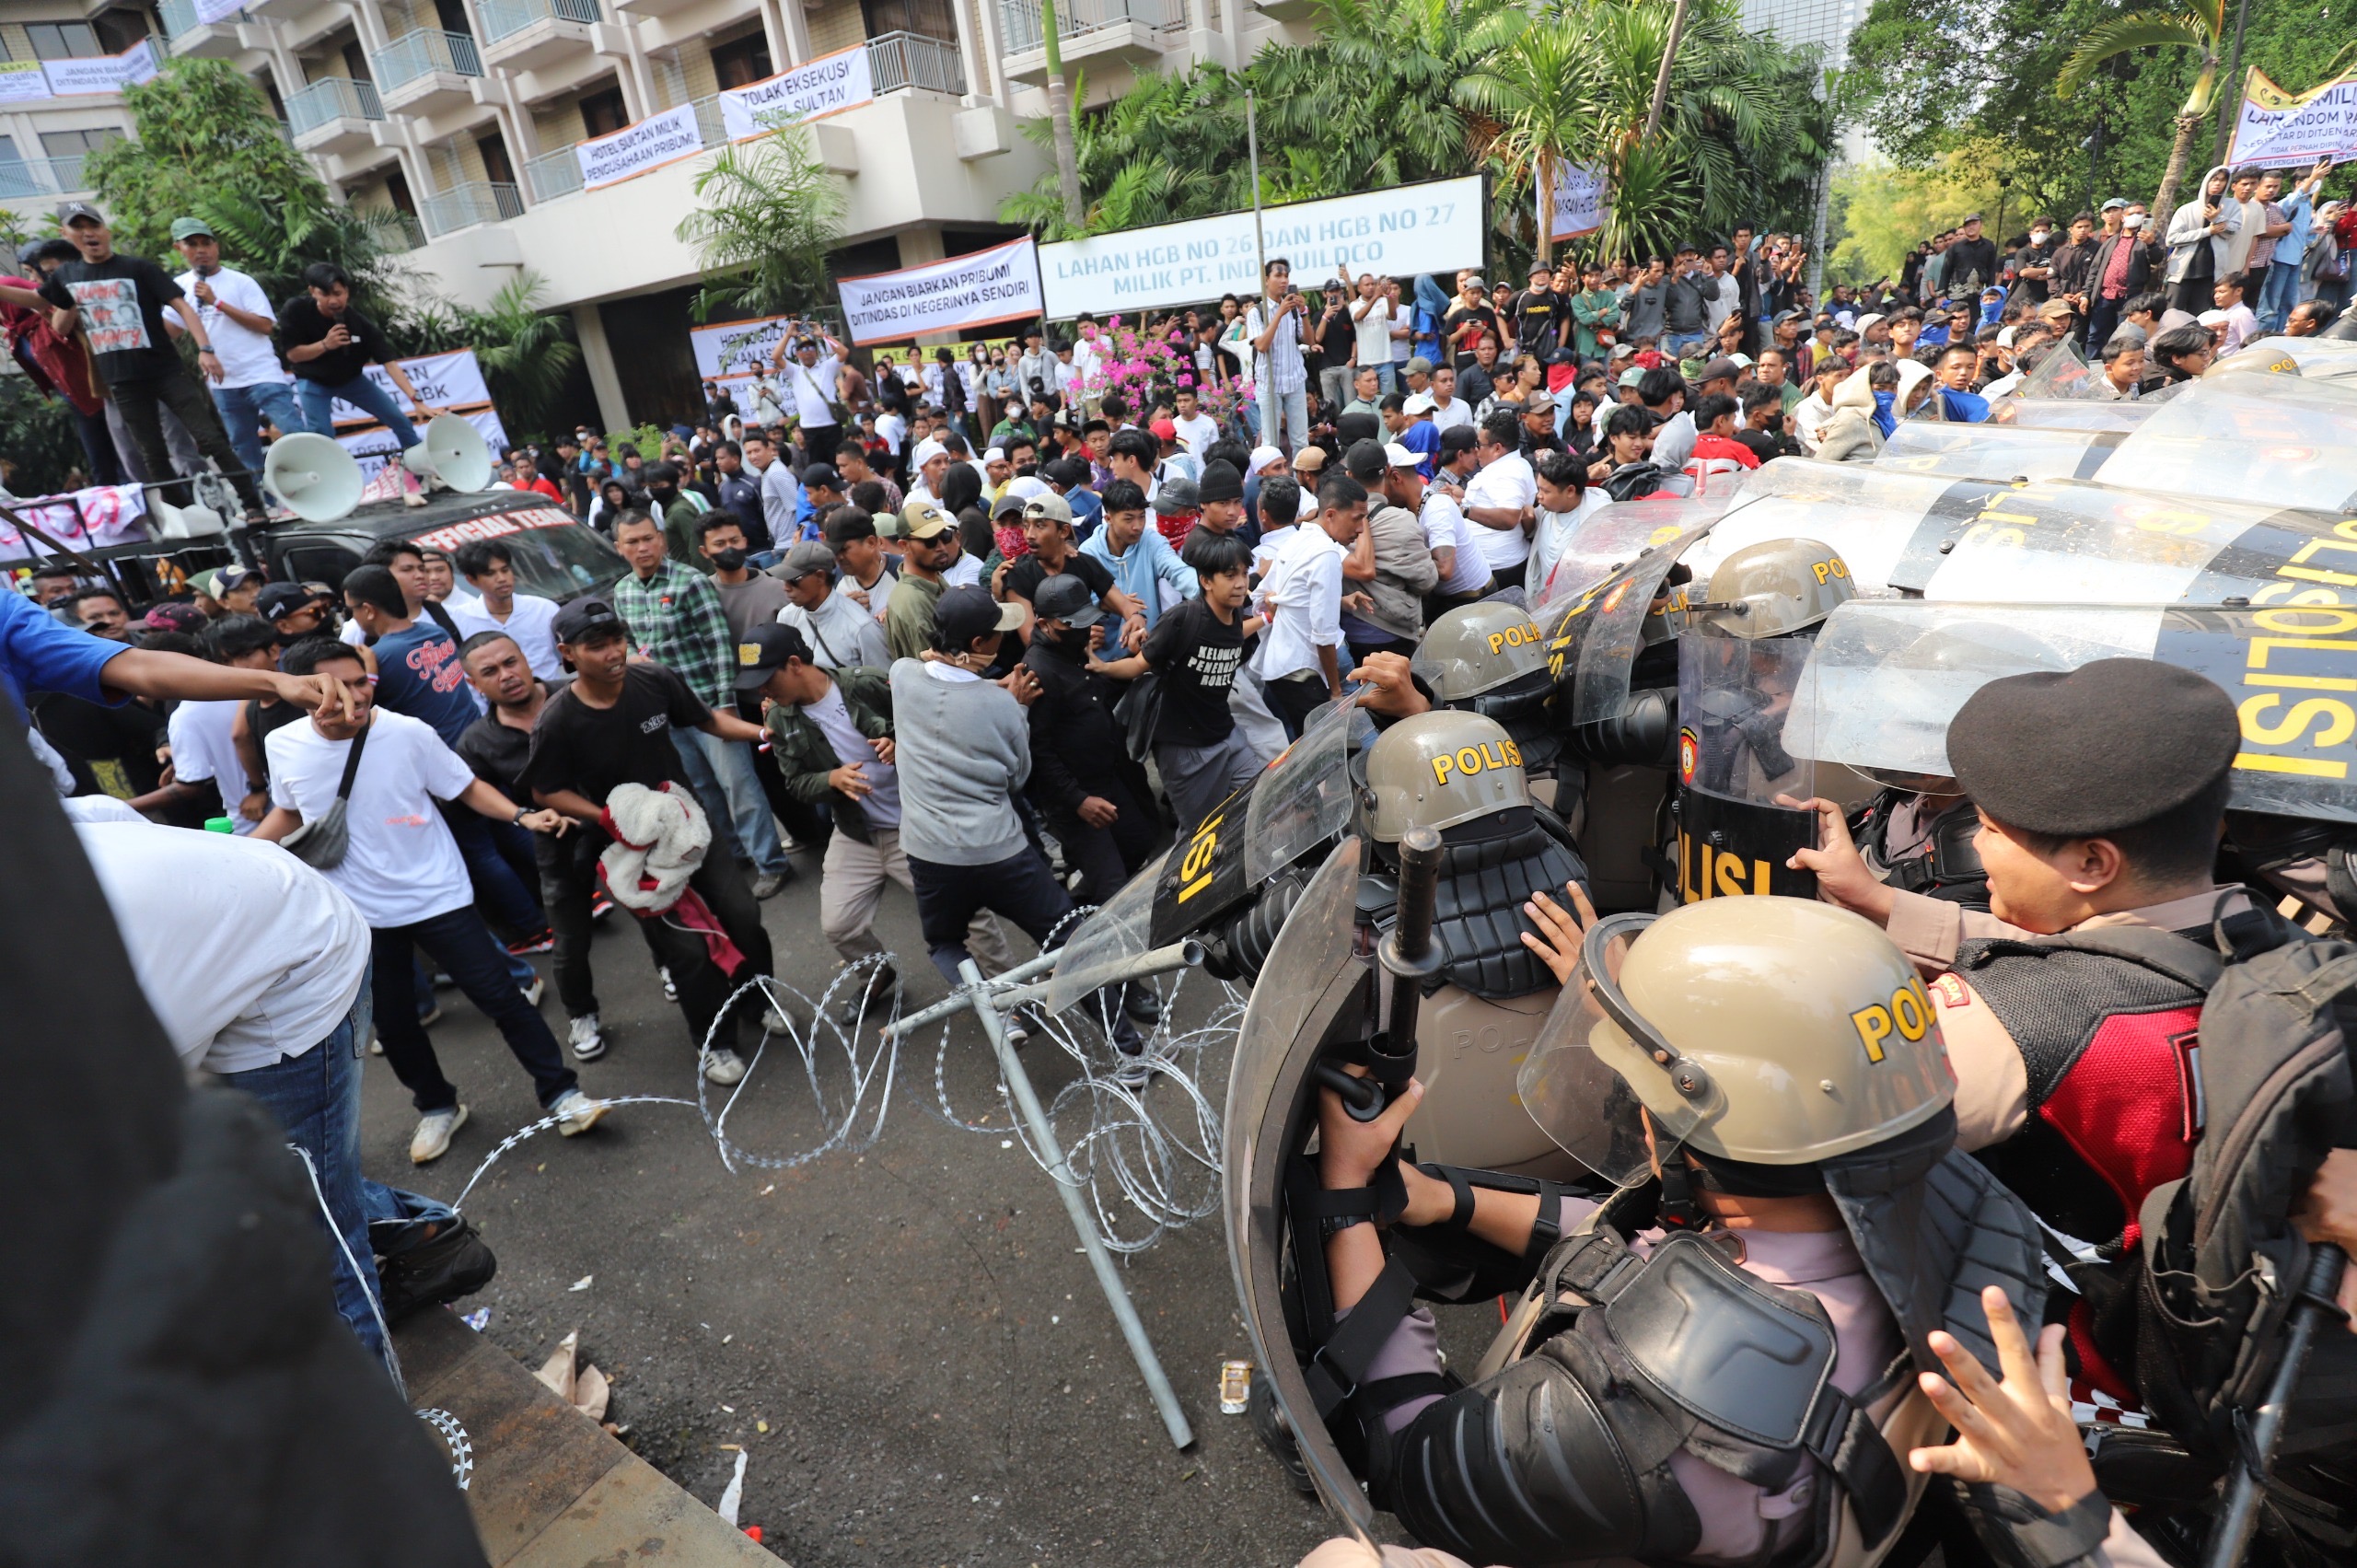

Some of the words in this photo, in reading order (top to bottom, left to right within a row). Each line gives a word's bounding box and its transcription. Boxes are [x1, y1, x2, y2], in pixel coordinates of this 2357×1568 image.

[741, 86, 784, 108] TOLAK
[784, 60, 850, 95] EKSEKUSI
[586, 148, 654, 181] PENGUSAHAAN
[654, 132, 695, 157] PRIBUMI
[590, 141, 619, 161] HOTEL
[618, 129, 654, 151] SULTAN
[655, 116, 682, 137] MILIK
[1057, 252, 1130, 279] LAHAN
[1136, 245, 1180, 269] HGB
[1187, 238, 1219, 261] NO
[1226, 234, 1253, 255] 26
[1319, 215, 1371, 241] HGB
[1379, 208, 1417, 233] NO
[1425, 202, 1456, 226] 27
[860, 287, 906, 308] JANGAN
[907, 275, 959, 298] BIARKAN
[960, 263, 1011, 288] PRIBUMI
[1113, 270, 1173, 296] MILIK
[1180, 264, 1213, 287] PT.
[1219, 240, 1384, 283] INDUILDCO
[851, 307, 899, 326] DITINDAS
[900, 305, 911, 317] DI
[912, 292, 980, 316] NEGERINYA
[982, 280, 1029, 302] SENDIRI
[409, 514, 522, 552] FFICIAL
[507, 507, 577, 529] TEAM
[406, 638, 456, 679] Three
[1198, 645, 1242, 661] KELOMPO
[1200, 673, 1232, 687] ROKET
[1430, 739, 1525, 786] POLIS
